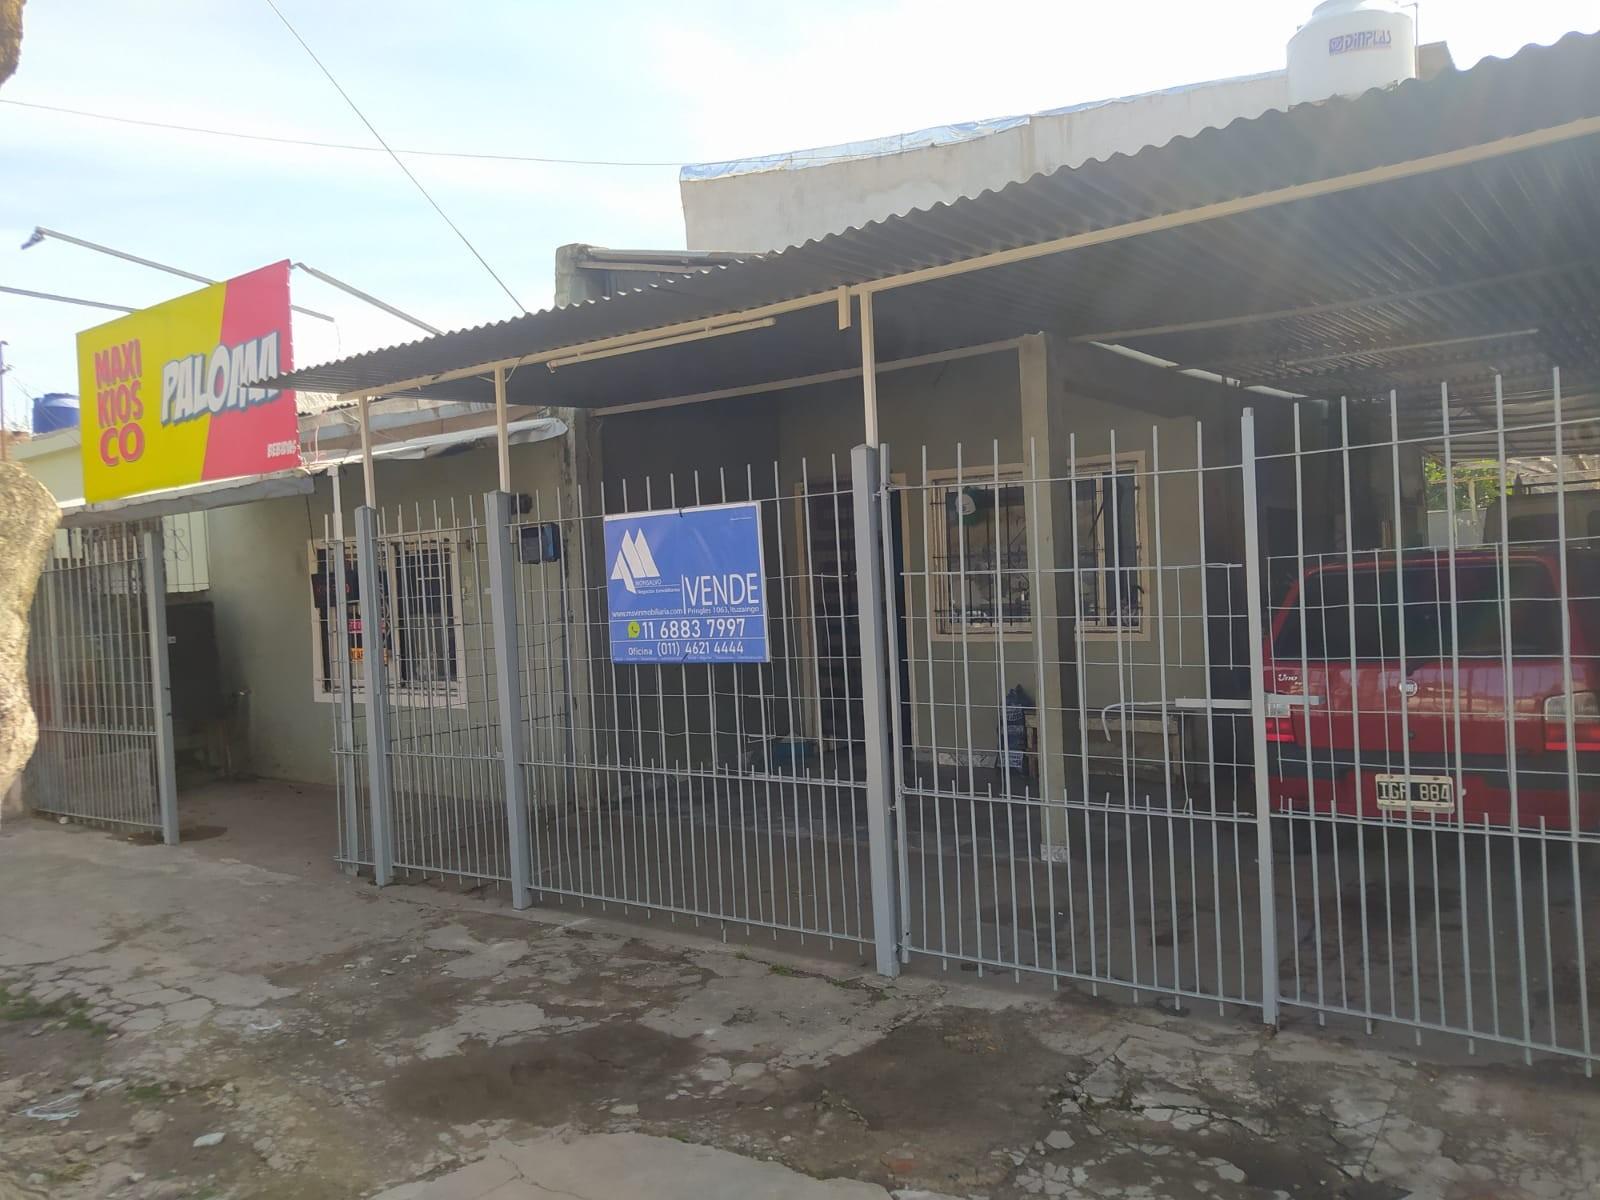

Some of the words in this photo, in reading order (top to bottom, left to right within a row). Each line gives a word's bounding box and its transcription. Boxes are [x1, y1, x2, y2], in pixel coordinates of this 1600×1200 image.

[94, 339, 143, 387] MAXI
[161, 330, 280, 427] PALOMA
[97, 380, 144, 428] KIOS
[100, 422, 145, 467] CO
[685, 573, 759, 606] VENDE
[642, 621, 655, 639] 11
[660, 620, 701, 639] 6883
[707, 618, 746, 637] 7997
[628, 647, 653, 656] Oficina
[657, 641, 681, 657] (011)
[685, 642, 710, 656] 4621
[714, 641, 744, 653] 4444
[1277, 674, 1298, 682] Uno
[1419, 784, 1450, 802] 884
